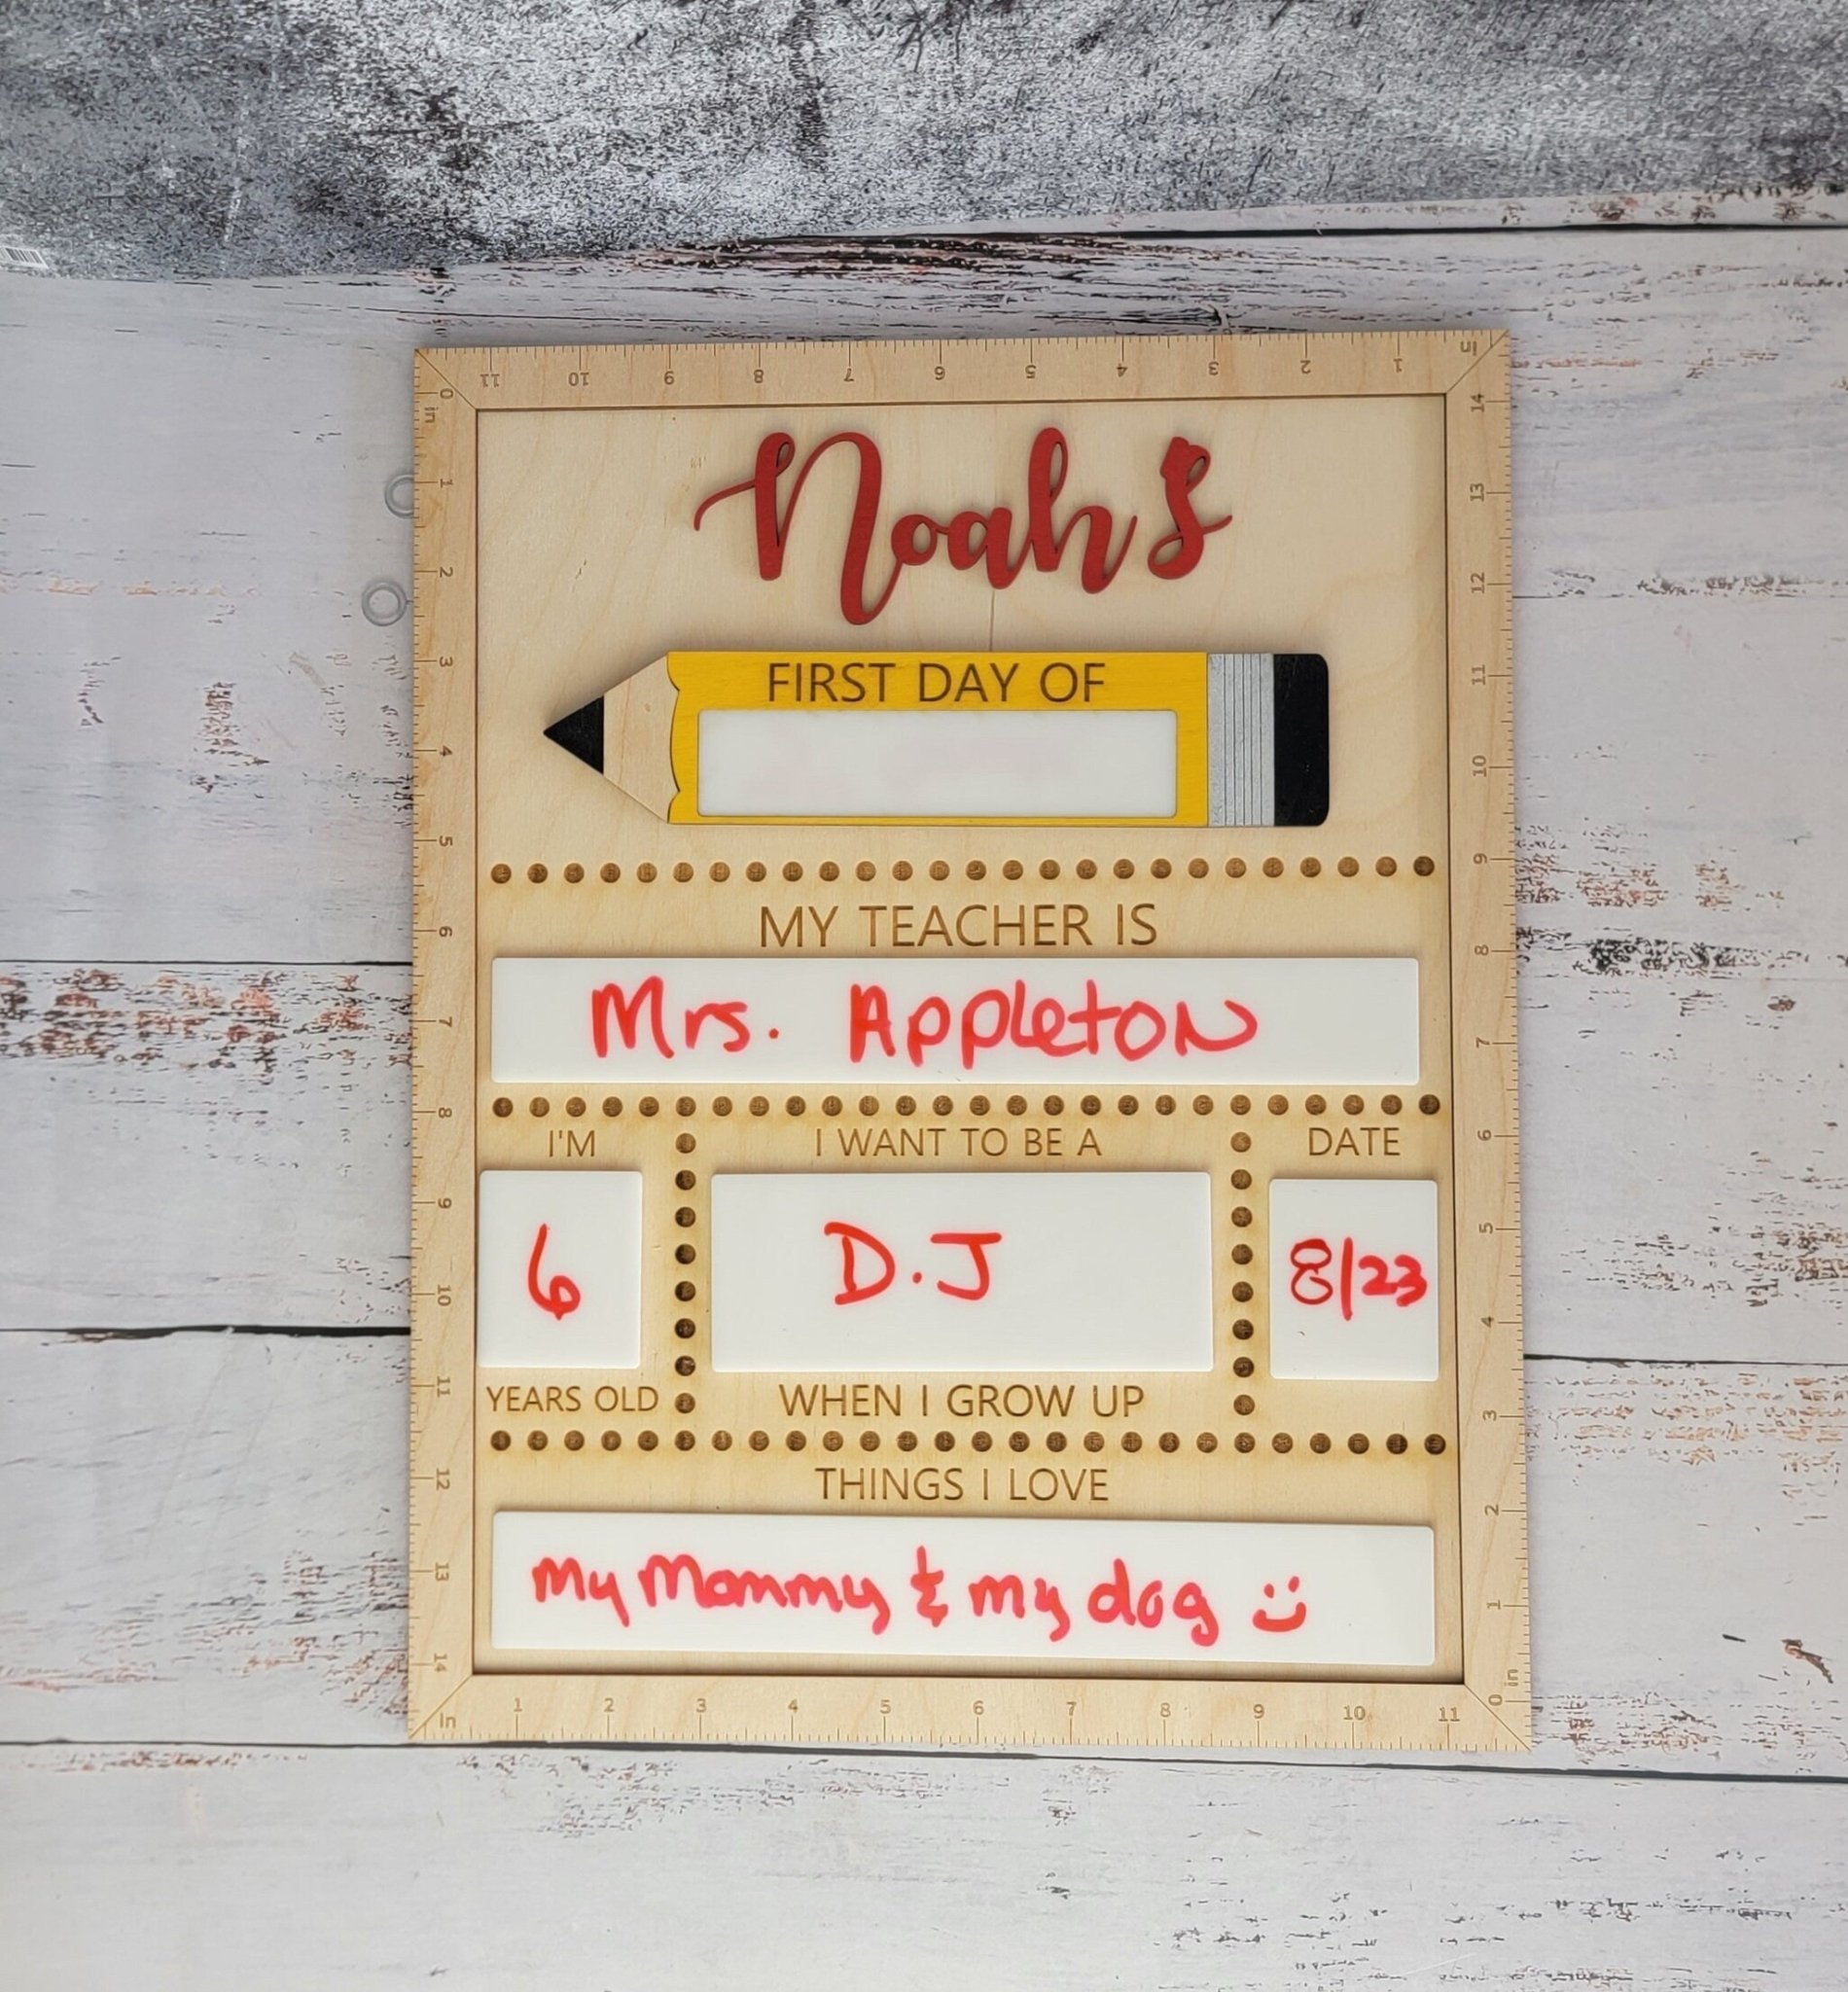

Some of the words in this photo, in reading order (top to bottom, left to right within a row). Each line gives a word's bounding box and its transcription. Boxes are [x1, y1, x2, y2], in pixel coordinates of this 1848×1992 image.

[1025, 365, 1036, 378] 5
[1117, 364, 1127, 377] 4
[1209, 362, 1219, 375] 3
[1300, 360, 1311, 374] 2
[1393, 358, 1403, 373] 1
[569, 373, 589, 386] 10
[664, 371, 674, 385] 9
[754, 370, 764, 383] 8
[844, 369, 854, 382] 7
[935, 367, 944, 380] 6
[480, 374, 500, 387] 11
[440, 388, 454, 400] 0
[1471, 393, 1484, 412] 14
[440, 479, 453, 488] 1
[1470, 482, 1484, 502] 13
[440, 567, 453, 578] 2
[1471, 572, 1485, 594] 12
[440, 657, 453, 667] 3
[1472, 664, 1486, 685] 11
[769, 662, 896, 702] FIRST
[919, 663, 1019, 702] DAY
[1040, 662, 1105, 702] OF
[440, 746, 452, 757] 4
[1473, 755, 1487, 777] 10
[440, 836, 453, 846] 5
[1474, 853, 1487, 864] 9
[439, 926, 452, 937] 6
[761, 906, 838, 947] MY
[859, 905, 1092, 946] TEACHER
[1118, 904, 1156, 945] IS
[1475, 944, 1489, 956] 8
[439, 1016, 452, 1027] 7
[590, 976, 779, 1058] Mrs.
[1476, 1037, 1490, 1048] 7
[439, 1108, 452, 1119] 8
[1309, 1127, 1400, 1156] DATE
[1477, 1129, 1491, 1141] 6
[550, 1130, 594, 1157] I'M
[817, 1128, 821, 1156] I
[837, 1128, 946, 1156] WANT
[960, 1128, 1008, 1156] TO
[1025, 1128, 1062, 1156] BE
[1077, 1128, 1102, 1156] A
[438, 1198, 451, 1209] 9
[1479, 1223, 1493, 1234] 5
[526, 1224, 582, 1320] 6
[1290, 1237, 1429, 1321] 8/23
[438, 1285, 451, 1306] 10
[1481, 1316, 1494, 1328] 4
[437, 1376, 450, 1398] 11
[486, 1386, 581, 1411] YEARS
[595, 1386, 658, 1411] OLD
[779, 1385, 901, 1416] WHEN
[923, 1385, 928, 1416] I
[947, 1384, 1075, 1417] GROW
[1093, 1385, 1144, 1417] UP
[1482, 1410, 1497, 1421] 3
[437, 1469, 450, 1490] 12
[815, 1468, 963, 1501] THINGS
[983, 1469, 988, 1500] I
[1010, 1468, 1108, 1501] LOVE
[1484, 1504, 1499, 1515] 2
[435, 1563, 449, 1582] 13
[968, 1574, 1071, 1642] my
[1086, 1558, 1220, 1648] dog
[1486, 1600, 1501, 1610] 1
[434, 1654, 447, 1672] 14
[1488, 1694, 1503, 1706] 0
[514, 1698, 522, 1712] 1
[604, 1698, 614, 1712] 2
[696, 1698, 706, 1713] 3
[788, 1699, 799, 1713] 4
[880, 1699, 891, 1714] 5
[974, 1700, 983, 1715] 6
[1067, 1701, 1077, 1716] 7
[1160, 1702, 1171, 1718] 8
[1254, 1704, 1264, 1719] 9
[1343, 1705, 1366, 1721] 10
[1439, 1707, 1460, 1722] 11
